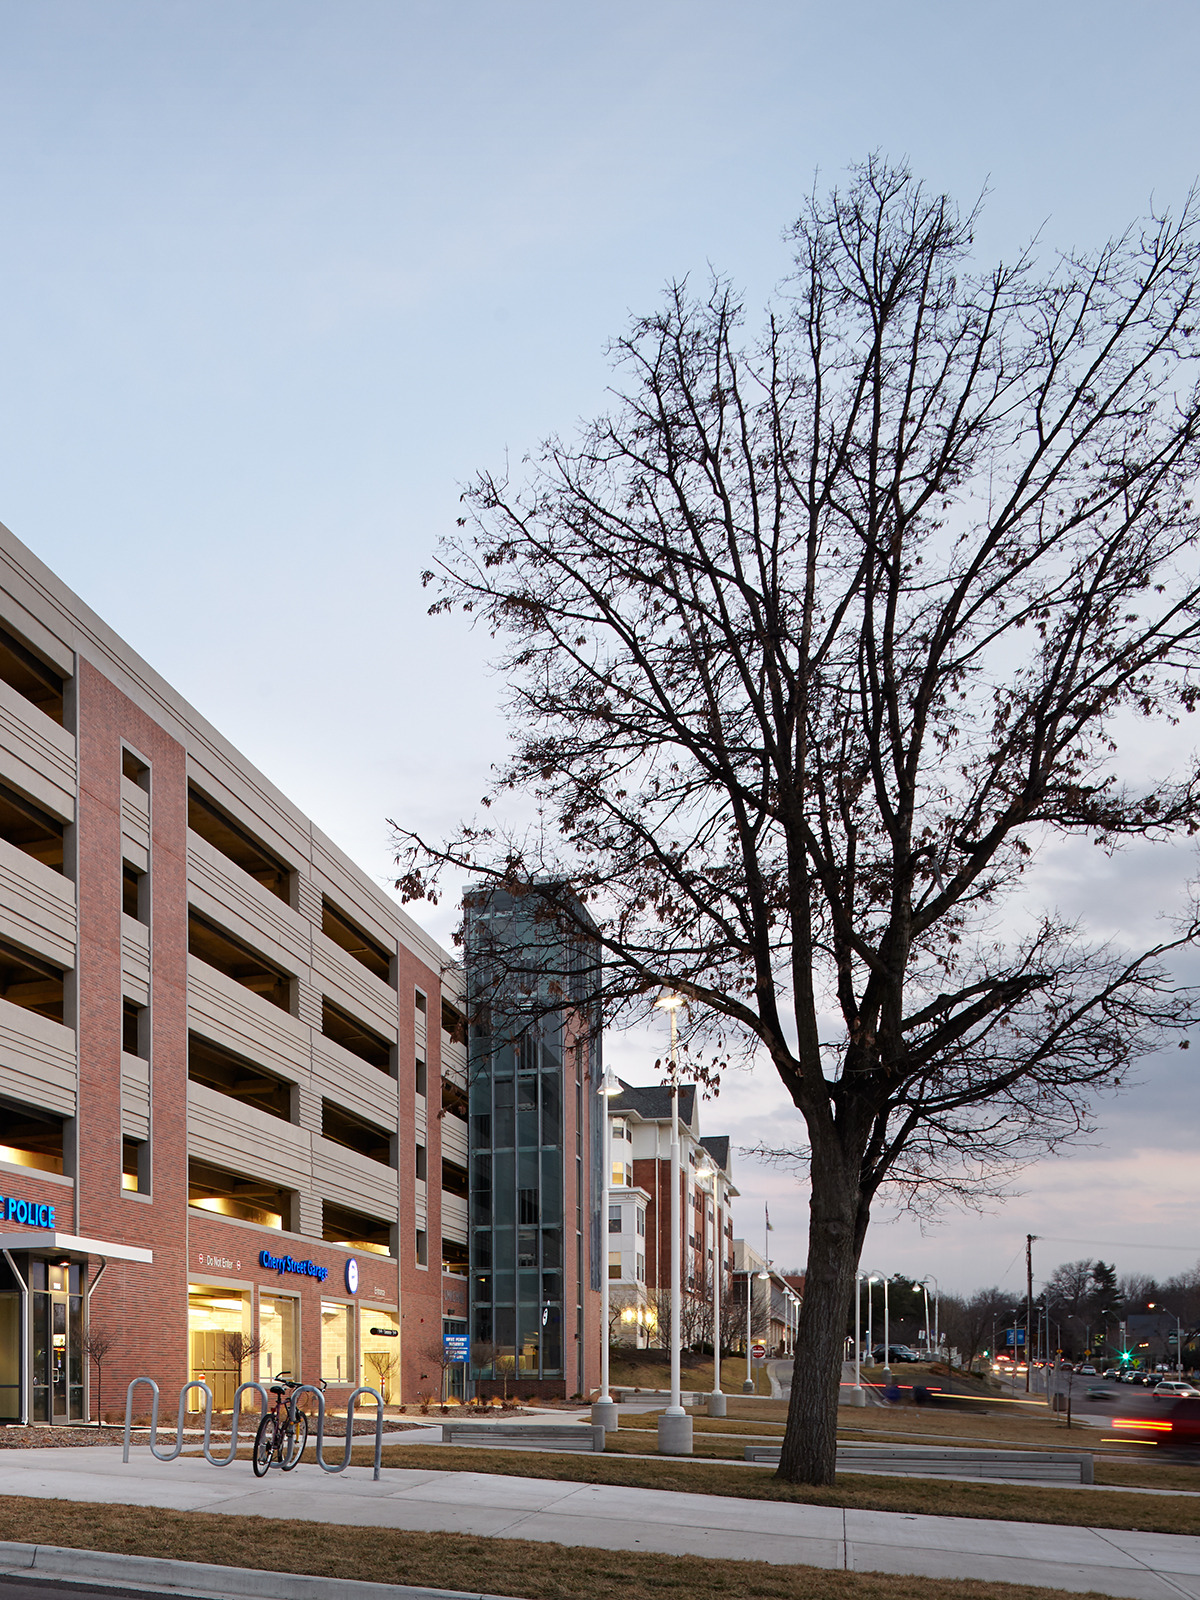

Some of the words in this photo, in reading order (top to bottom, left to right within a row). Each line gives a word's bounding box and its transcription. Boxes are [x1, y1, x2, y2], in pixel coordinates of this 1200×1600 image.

[6, 1198, 56, 1229] POLICE
[206, 1254, 213, 1266] Do
[213, 1256, 221, 1267] Not
[222, 1257, 233, 1269] Enter
[260, 1250, 286, 1275] Cherry
[285, 1255, 307, 1275] Street
[306, 1260, 329, 1282] Garage
